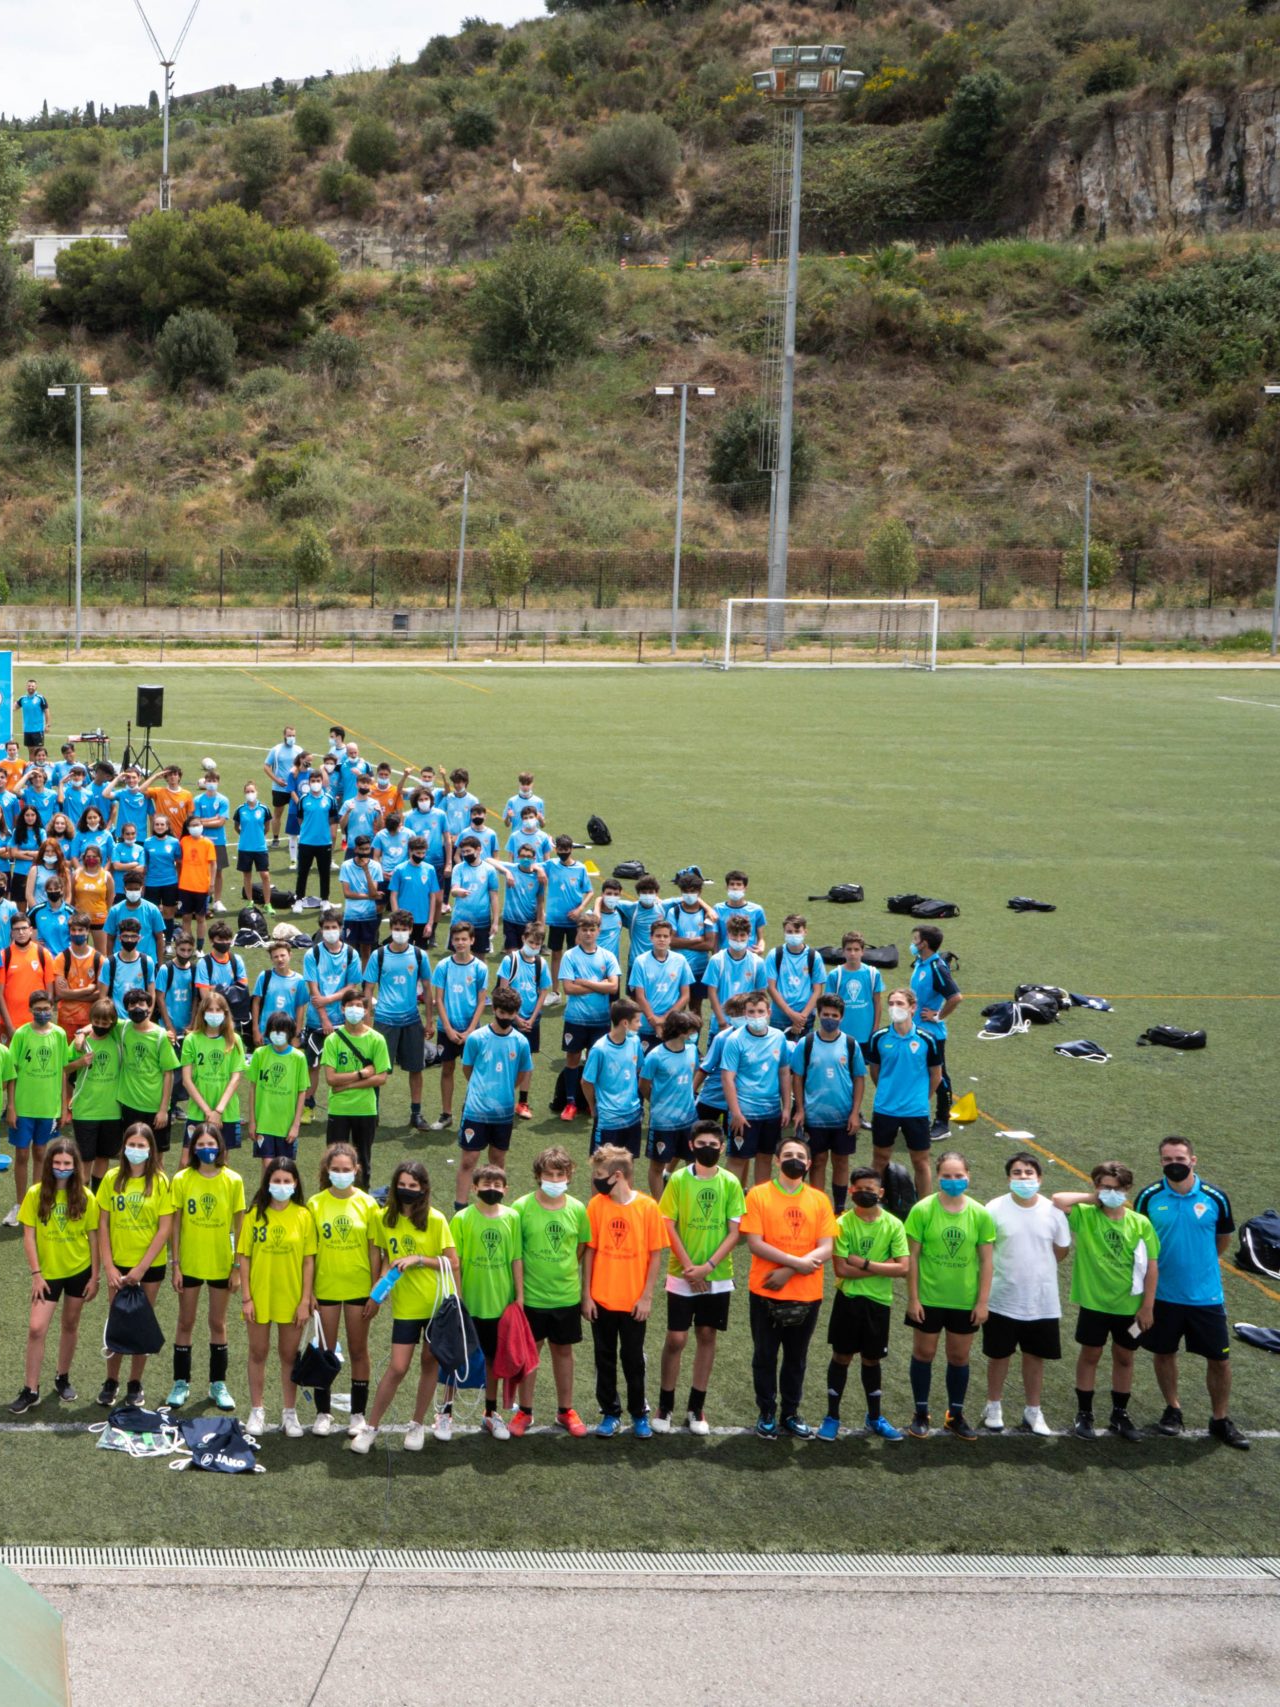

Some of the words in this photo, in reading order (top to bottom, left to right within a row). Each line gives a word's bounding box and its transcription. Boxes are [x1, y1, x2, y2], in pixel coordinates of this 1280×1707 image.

[733, 981, 740, 991] 7
[276, 996, 286, 1008] 5
[25, 1049, 32, 1062] 4
[197, 1053, 205, 1066] 2
[496, 1062, 503, 1072] 8
[761, 1062, 769, 1072] 4
[827, 1068, 834, 1078] 5
[259, 1070, 270, 1082] 14
[624, 1070, 631, 1080] 3
[111, 1195, 125, 1212] 18
[187, 1198, 197, 1215] 8
[322, 1223, 332, 1239] 3
[390, 1238, 398, 1254] 2
[214, 1453, 247, 1468] JAKO
